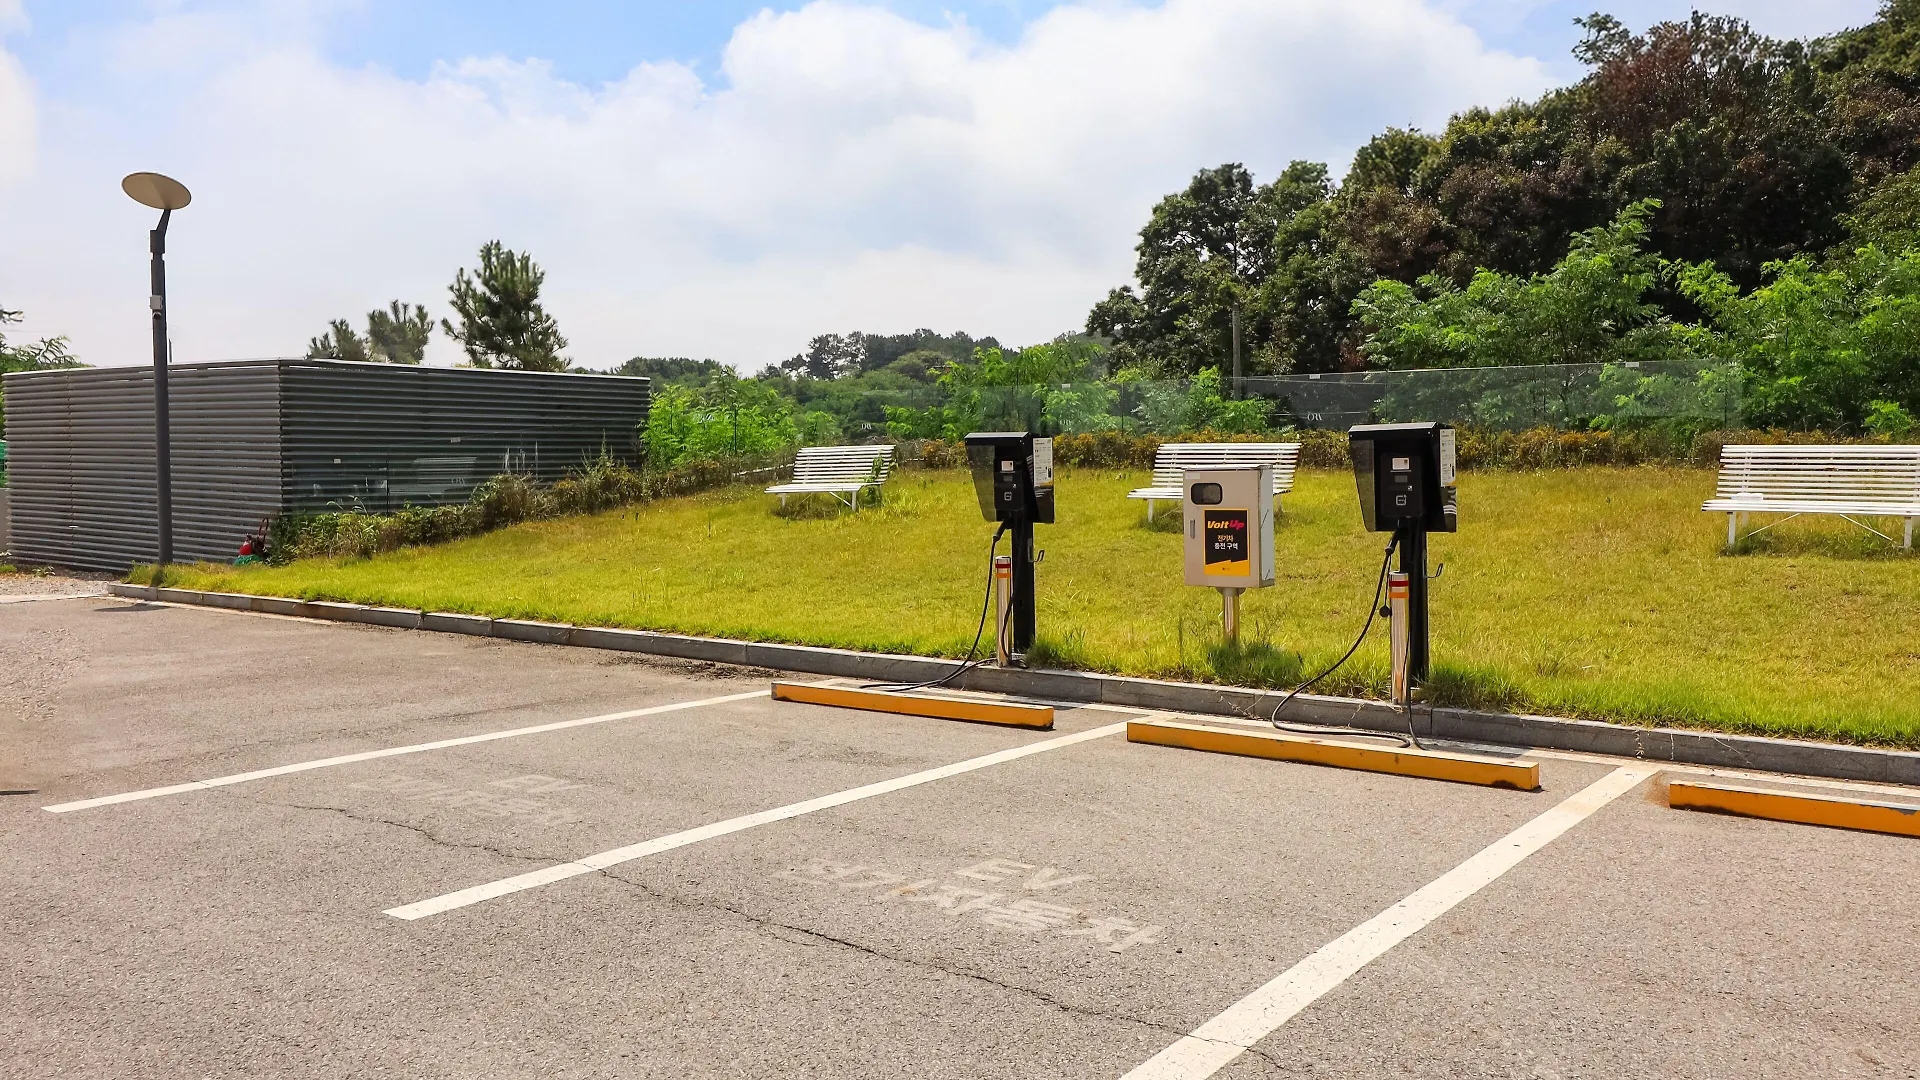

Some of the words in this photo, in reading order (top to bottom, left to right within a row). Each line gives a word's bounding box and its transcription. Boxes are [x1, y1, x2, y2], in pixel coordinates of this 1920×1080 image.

[1214, 542, 1226, 550] 충전
[1226, 542, 1239, 550] 구역
[954, 858, 1097, 889] EV
[771, 859, 1165, 952] 전기자동차
